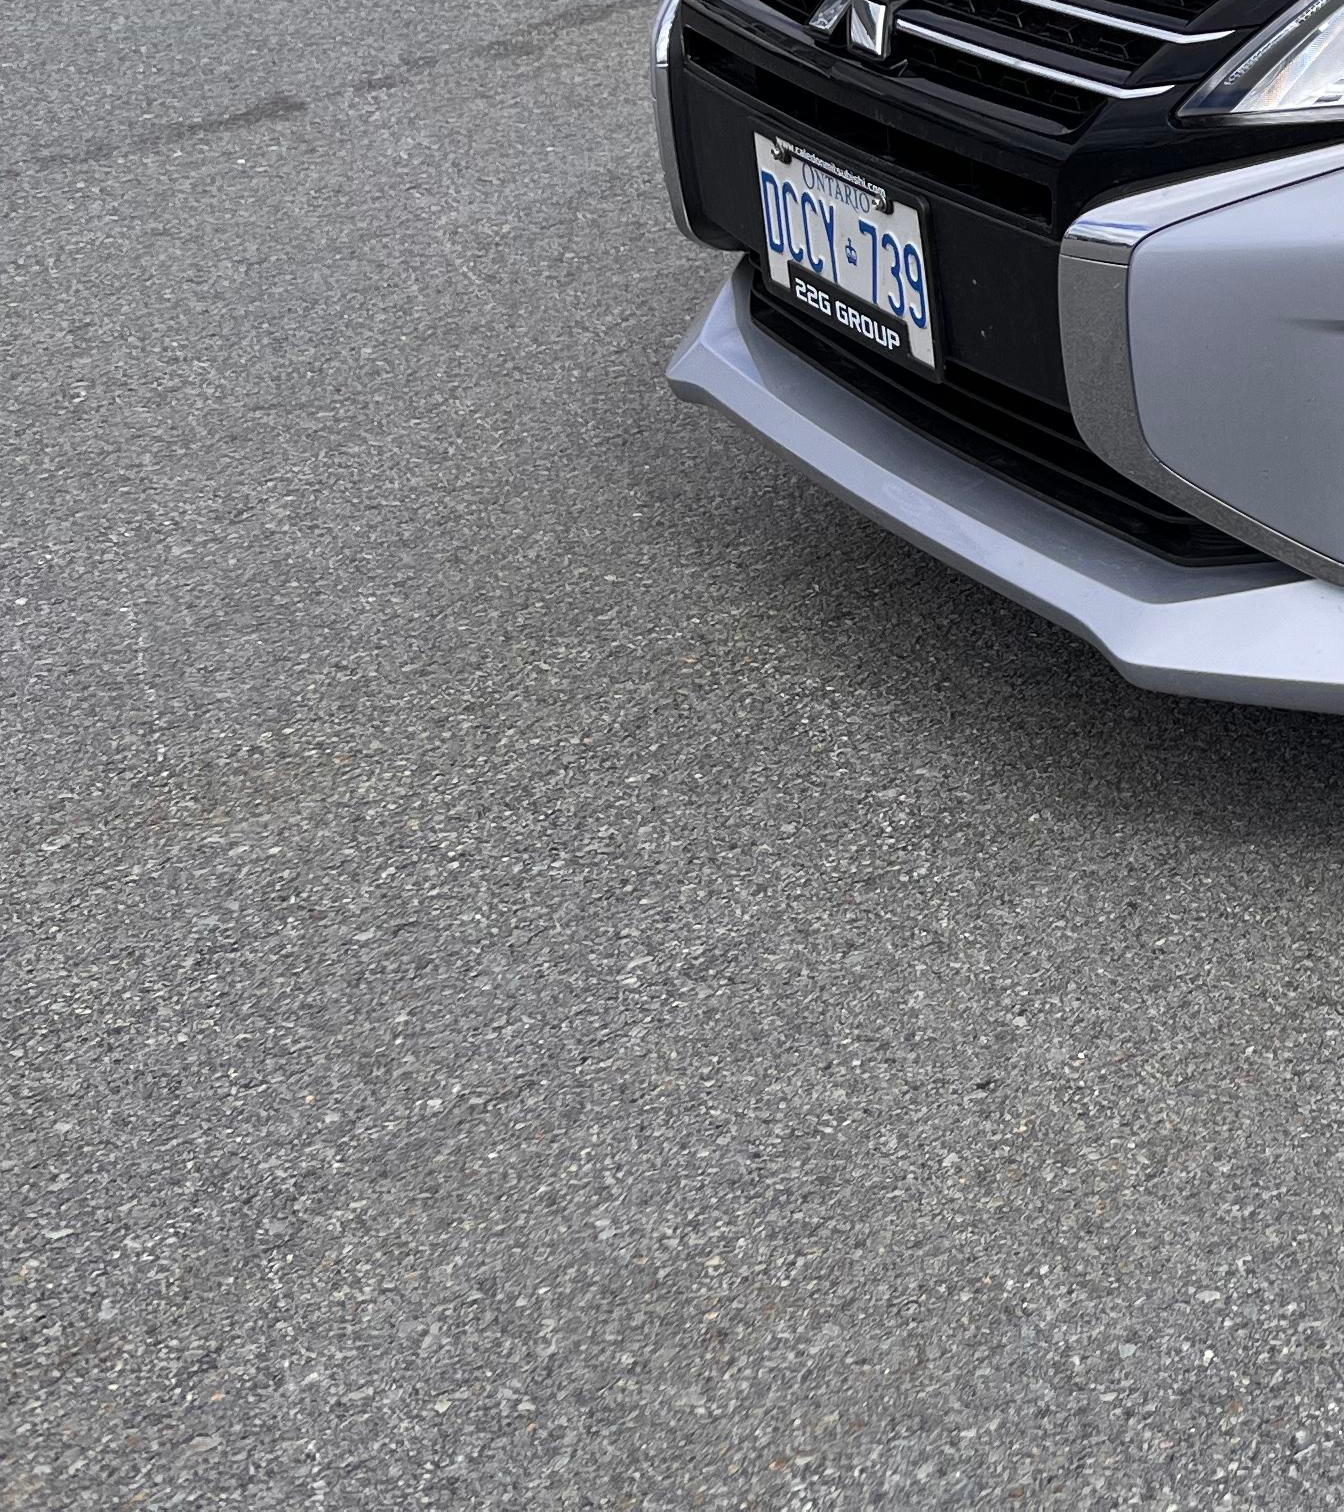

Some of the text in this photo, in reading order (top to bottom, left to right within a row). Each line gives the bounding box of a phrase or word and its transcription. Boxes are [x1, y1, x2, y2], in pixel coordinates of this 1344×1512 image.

[802, 162, 870, 213] ONTARIO
[761, 170, 927, 329] DCCY 739
[835, 300, 901, 350] GROUP
